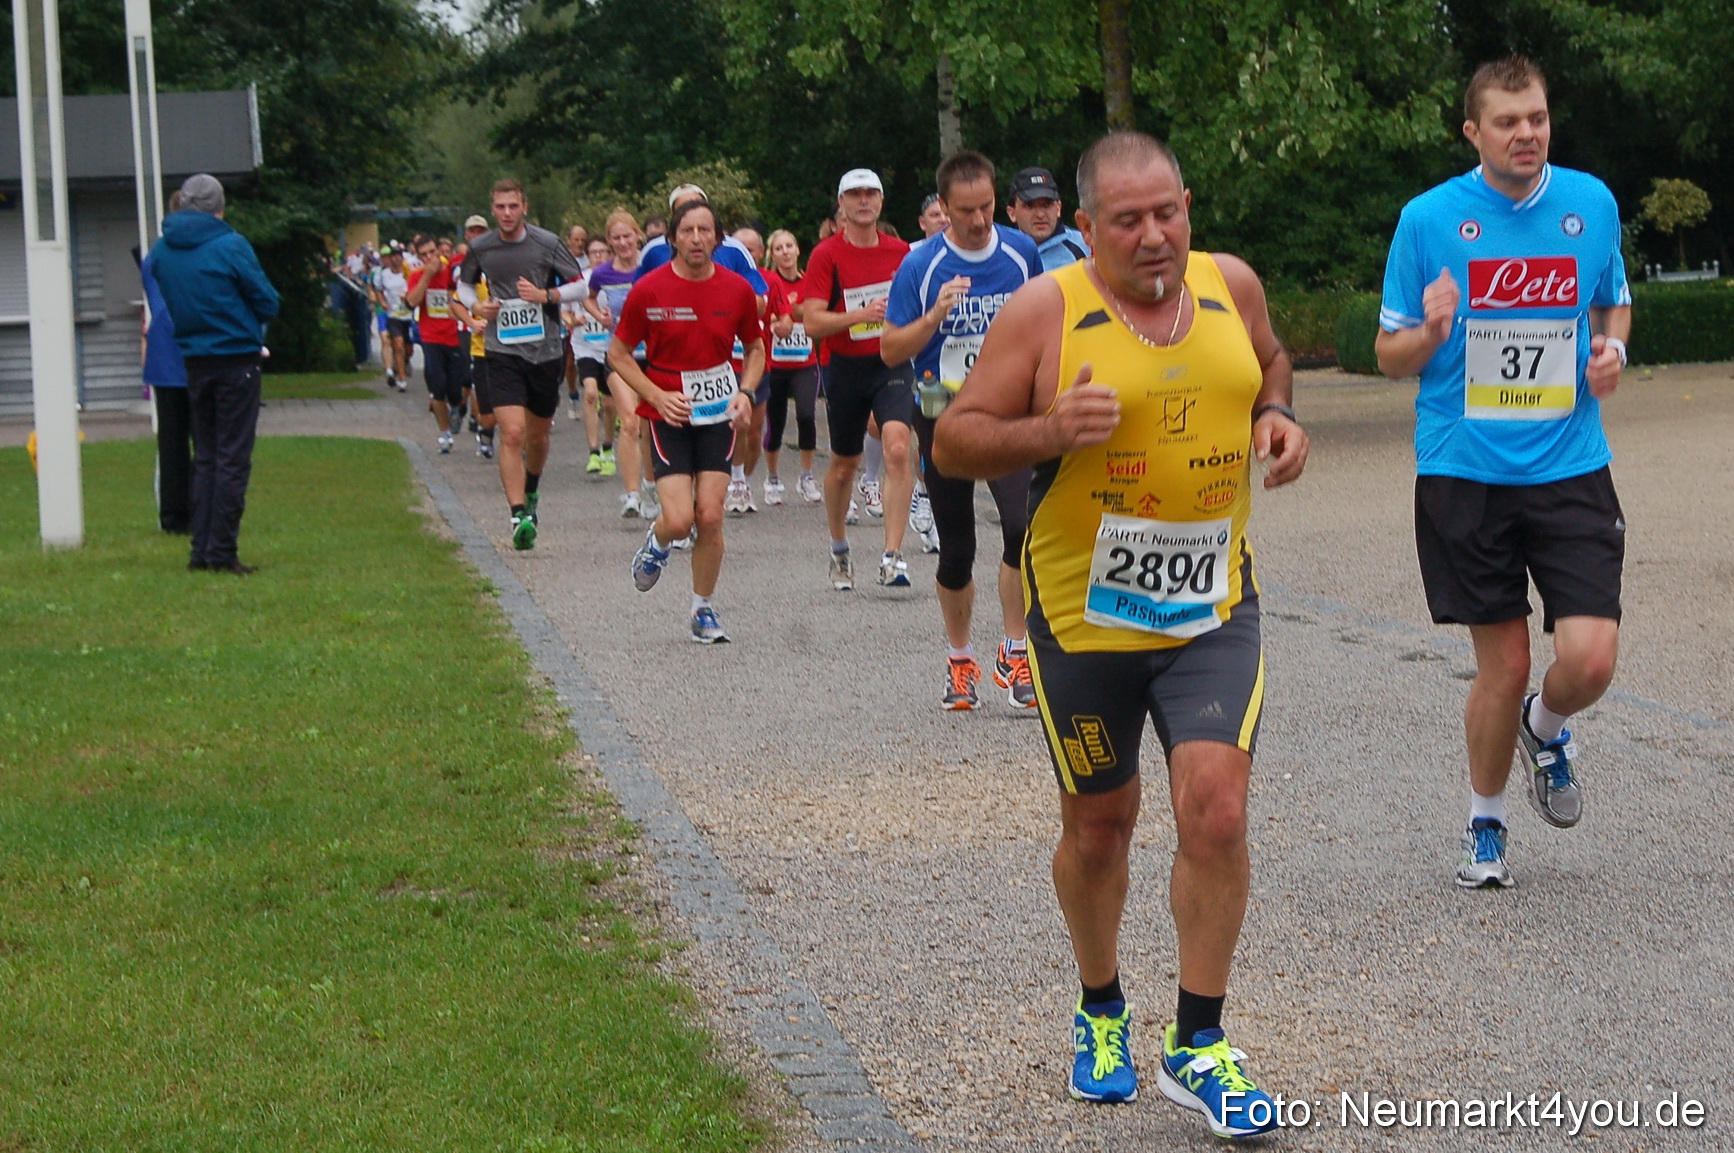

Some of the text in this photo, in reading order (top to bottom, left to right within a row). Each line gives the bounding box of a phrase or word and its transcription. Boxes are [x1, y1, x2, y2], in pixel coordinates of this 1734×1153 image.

[1470, 258, 1577, 309] Lete
[501, 308, 538, 327] 3082
[1469, 329, 1559, 341] PARTL Neumarkt
[1500, 344, 1546, 381] 37
[690, 375, 733, 402] 2583
[1499, 389, 1543, 407] Dieter
[1106, 460, 1147, 476] Seidl
[1101, 526, 1213, 547] PARTL Neumarkt
[1105, 546, 1217, 595] 2890
[1080, 721, 1111, 764] Run!
